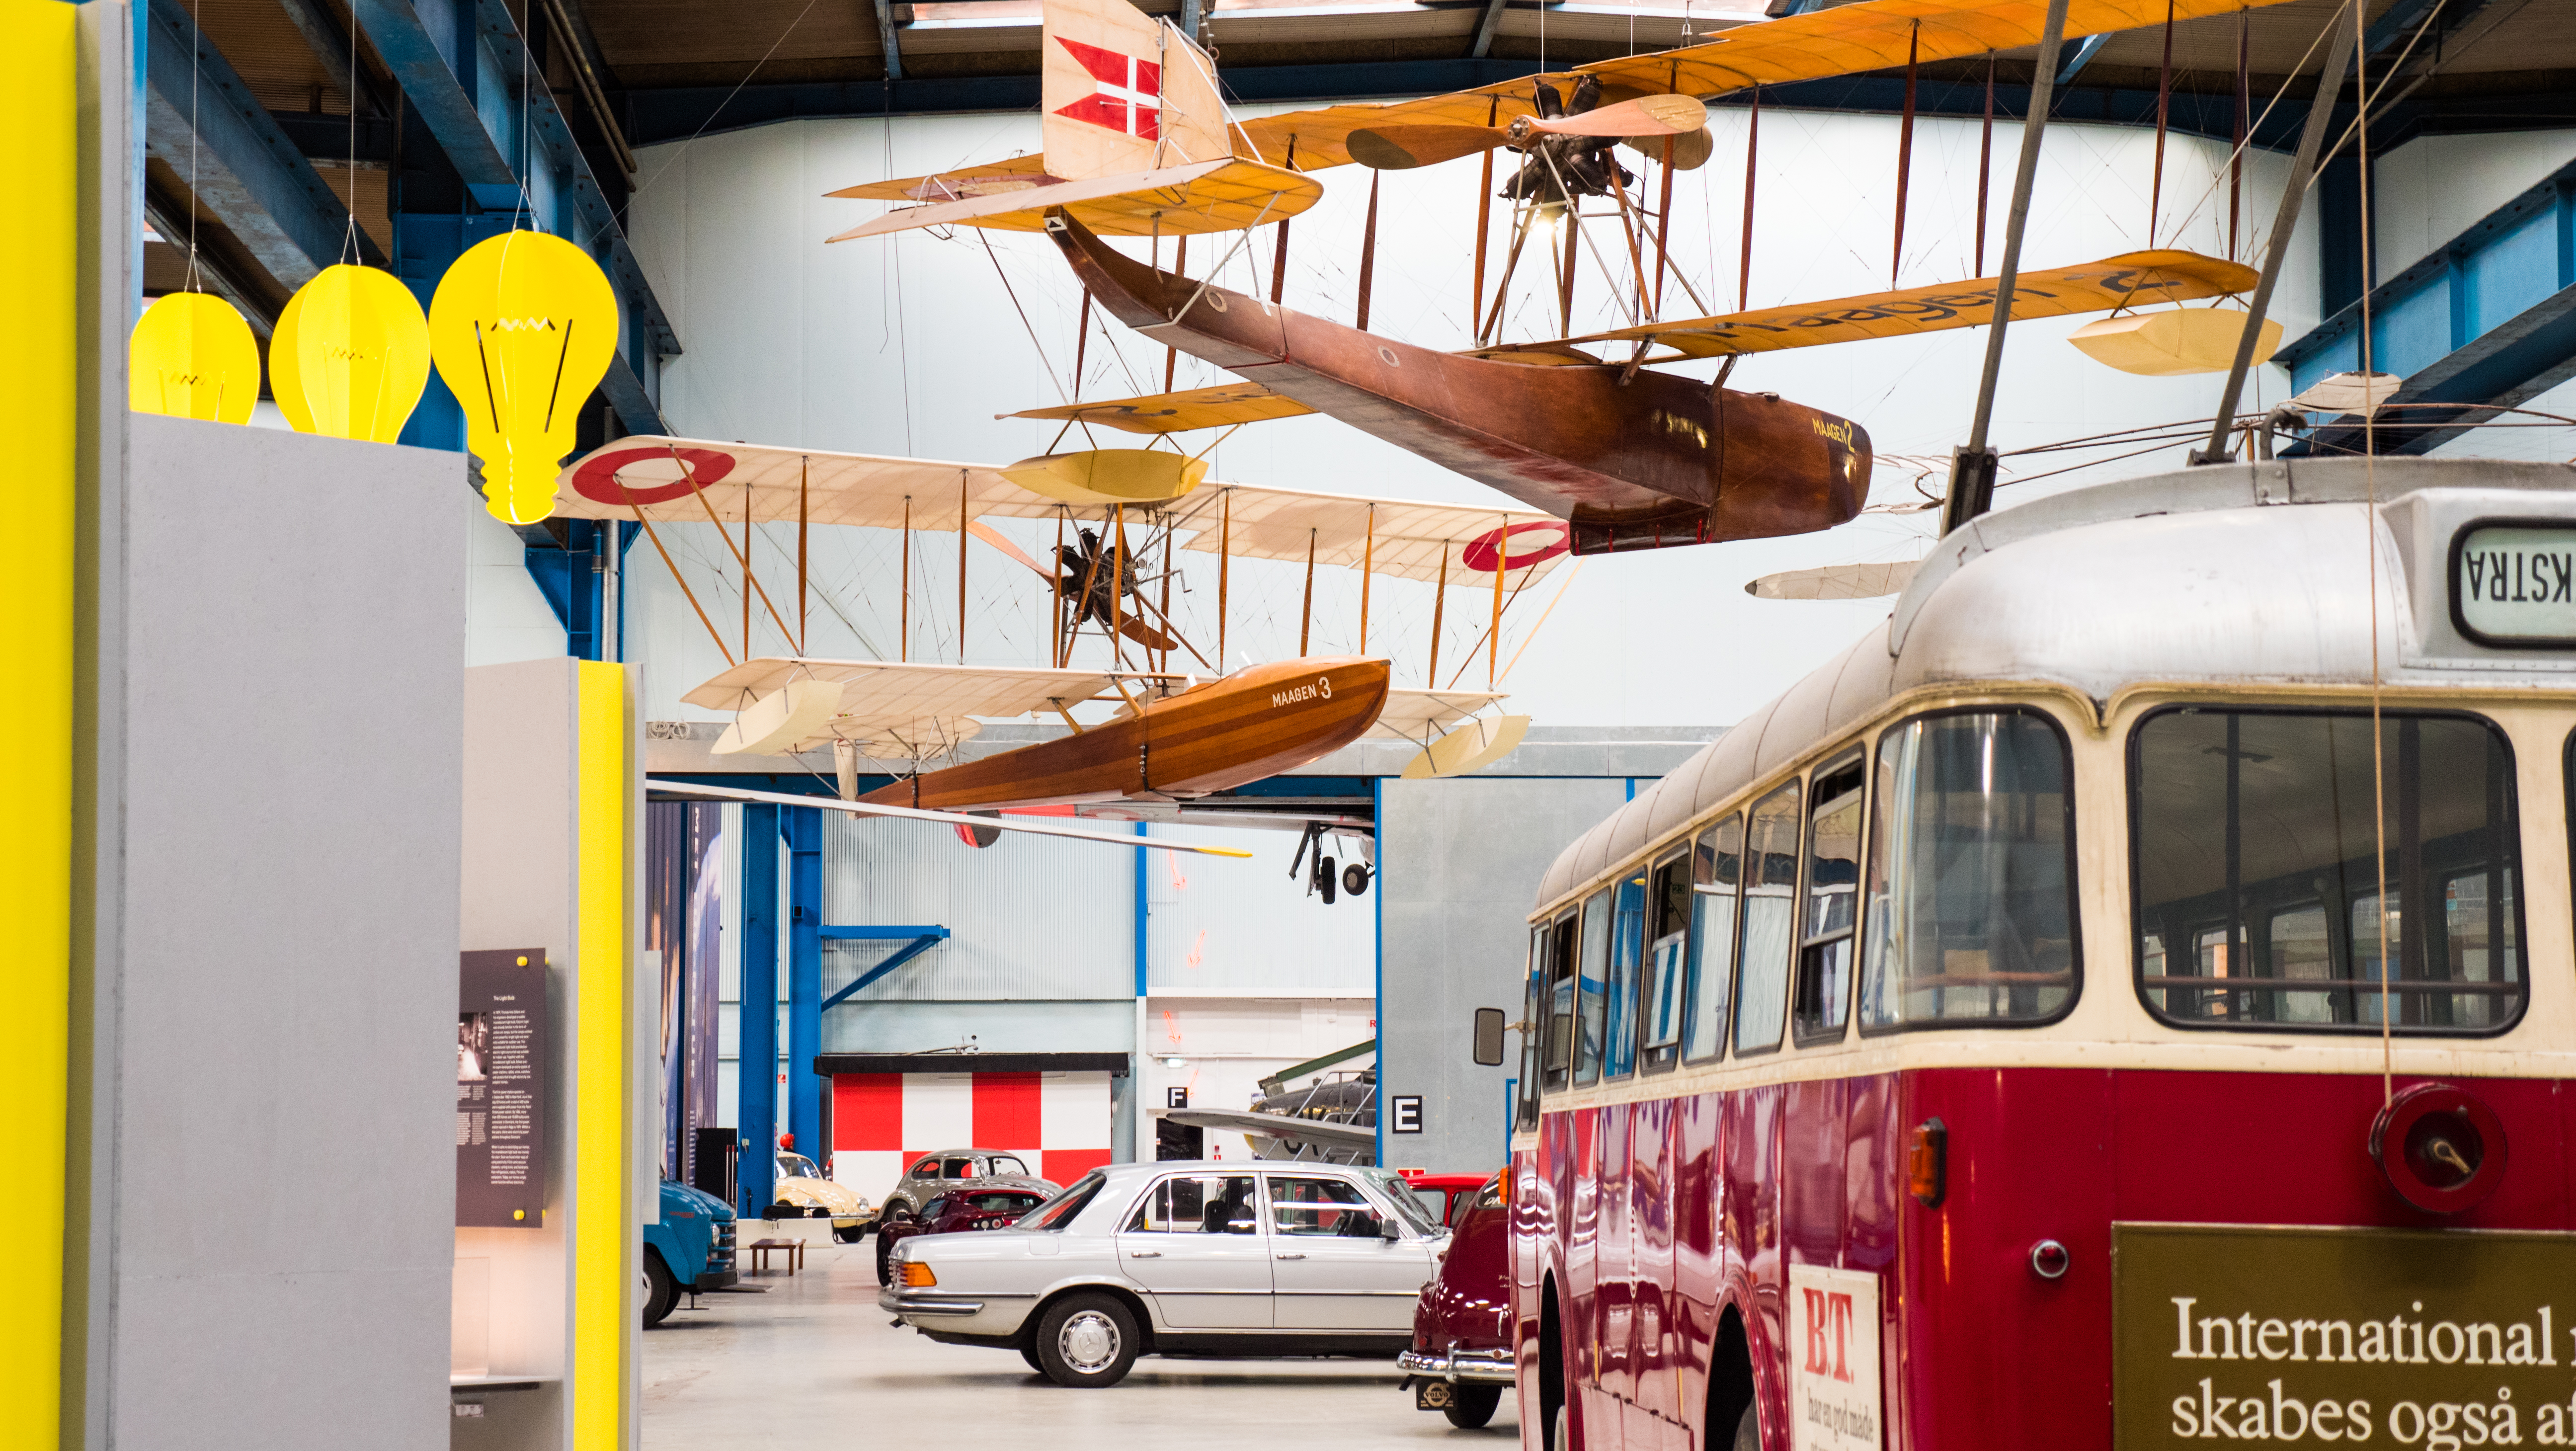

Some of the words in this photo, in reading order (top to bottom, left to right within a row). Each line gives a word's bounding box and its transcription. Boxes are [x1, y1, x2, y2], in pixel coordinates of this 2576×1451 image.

[1812, 418, 1847, 445] MAAGEN
[1844, 420, 1855, 453] 2
[1273, 684, 1317, 708] MAAGEN
[1319, 676, 1332, 699] 3
[1171, 1089, 1184, 1106] F
[1396, 1099, 1419, 1130] E
[1803, 1288, 1854, 1384] B.T.
[2171, 1297, 2557, 1366] International
[1808, 1387, 1822, 1424] har
[1833, 1398, 1848, 1443] god
[2172, 1378, 2372, 1441] skabes
[2389, 1387, 2522, 1451] også
